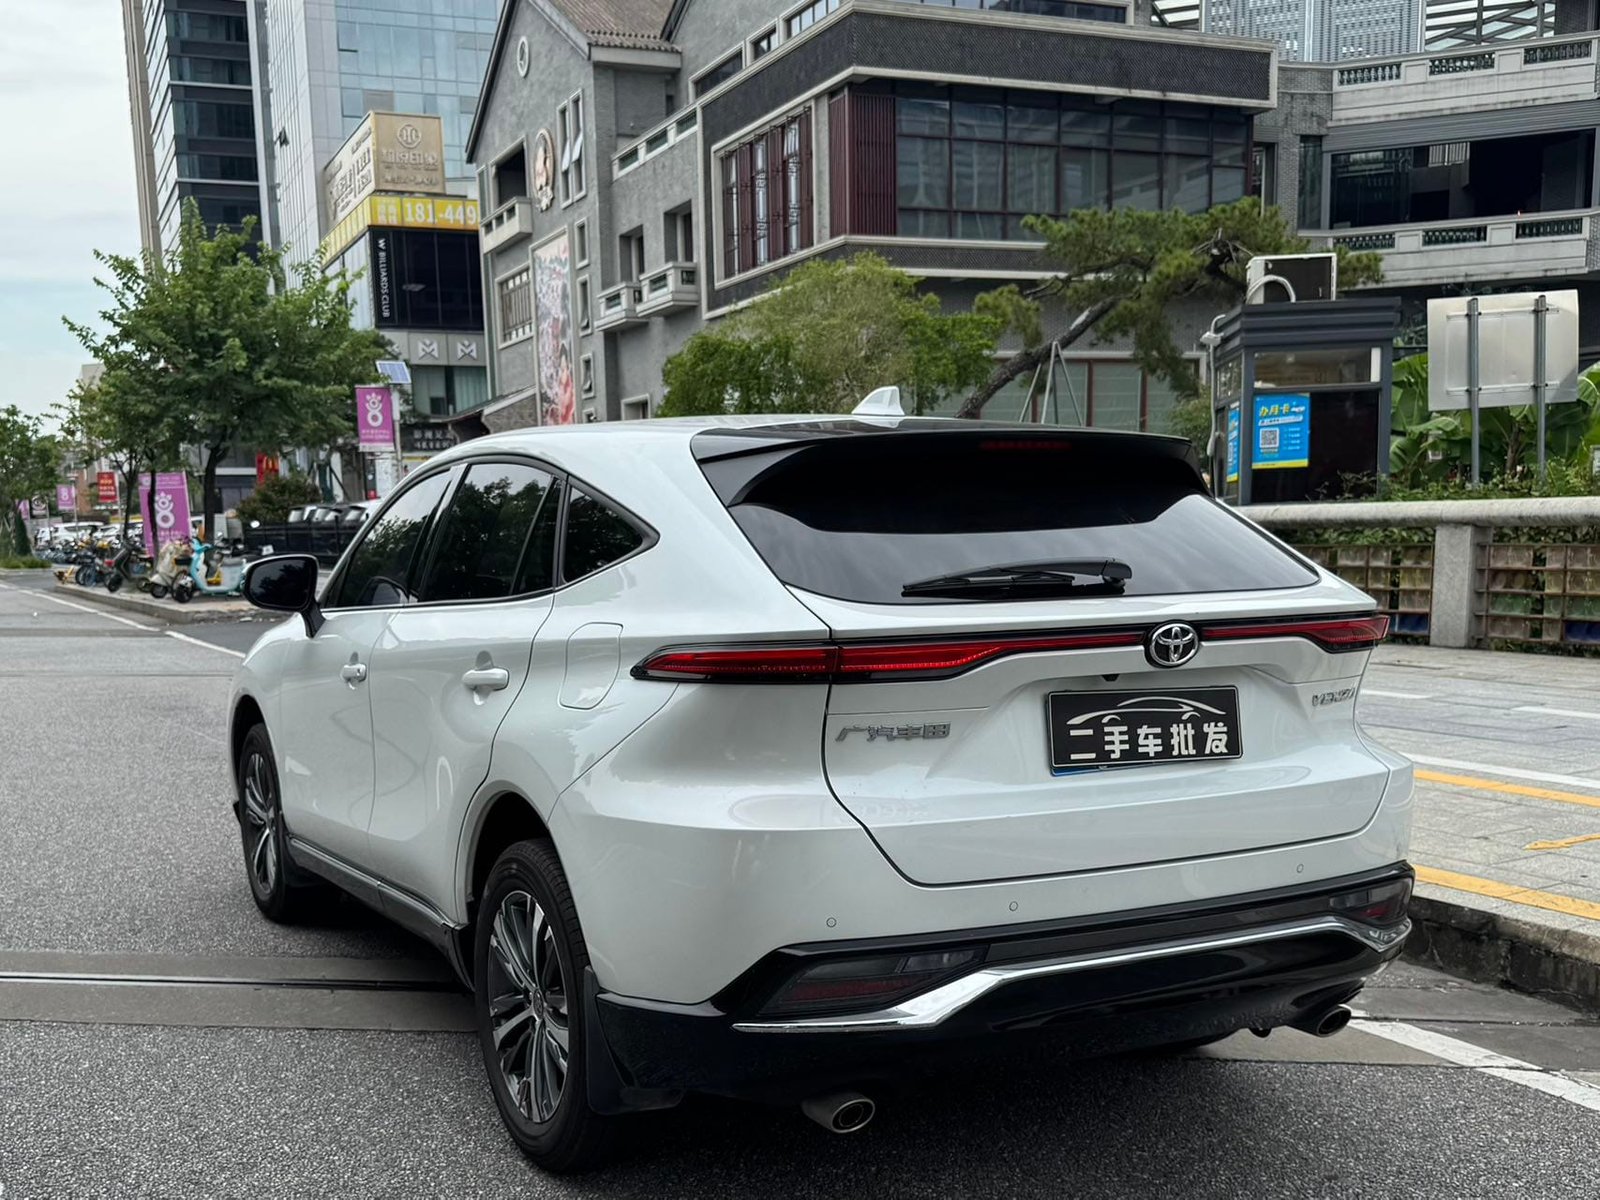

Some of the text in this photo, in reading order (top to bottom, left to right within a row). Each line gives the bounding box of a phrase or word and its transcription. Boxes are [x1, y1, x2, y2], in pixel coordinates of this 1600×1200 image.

[377, 238, 391, 318] W BILLIARDS CLUB
[835, 721, 952, 743] 广汽丰田
[1069, 722, 1229, 761] 二手车批发
